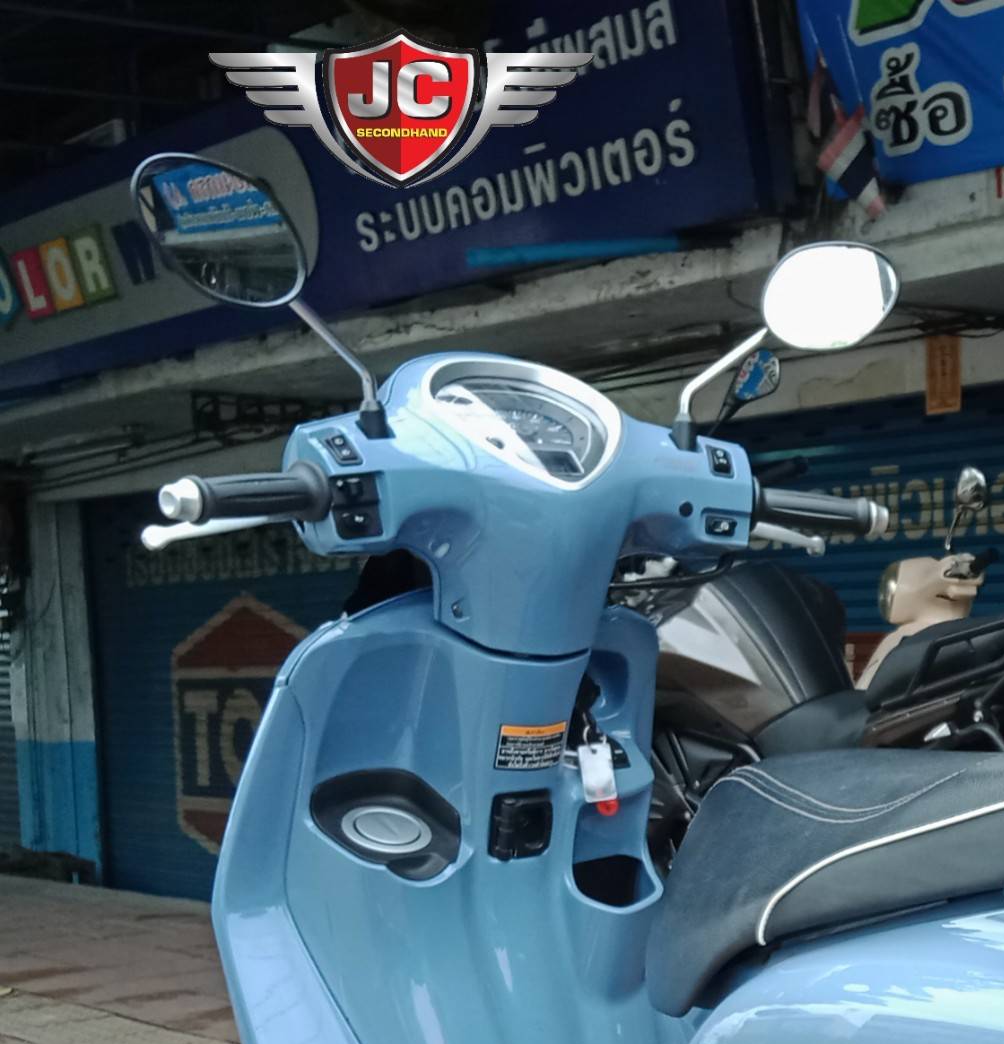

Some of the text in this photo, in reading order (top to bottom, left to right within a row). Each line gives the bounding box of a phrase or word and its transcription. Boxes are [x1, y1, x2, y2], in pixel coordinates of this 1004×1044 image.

[875, 52, 967, 149] ซื้อ
[356, 97, 697, 252] ระบบคอมพิวเตอร์
